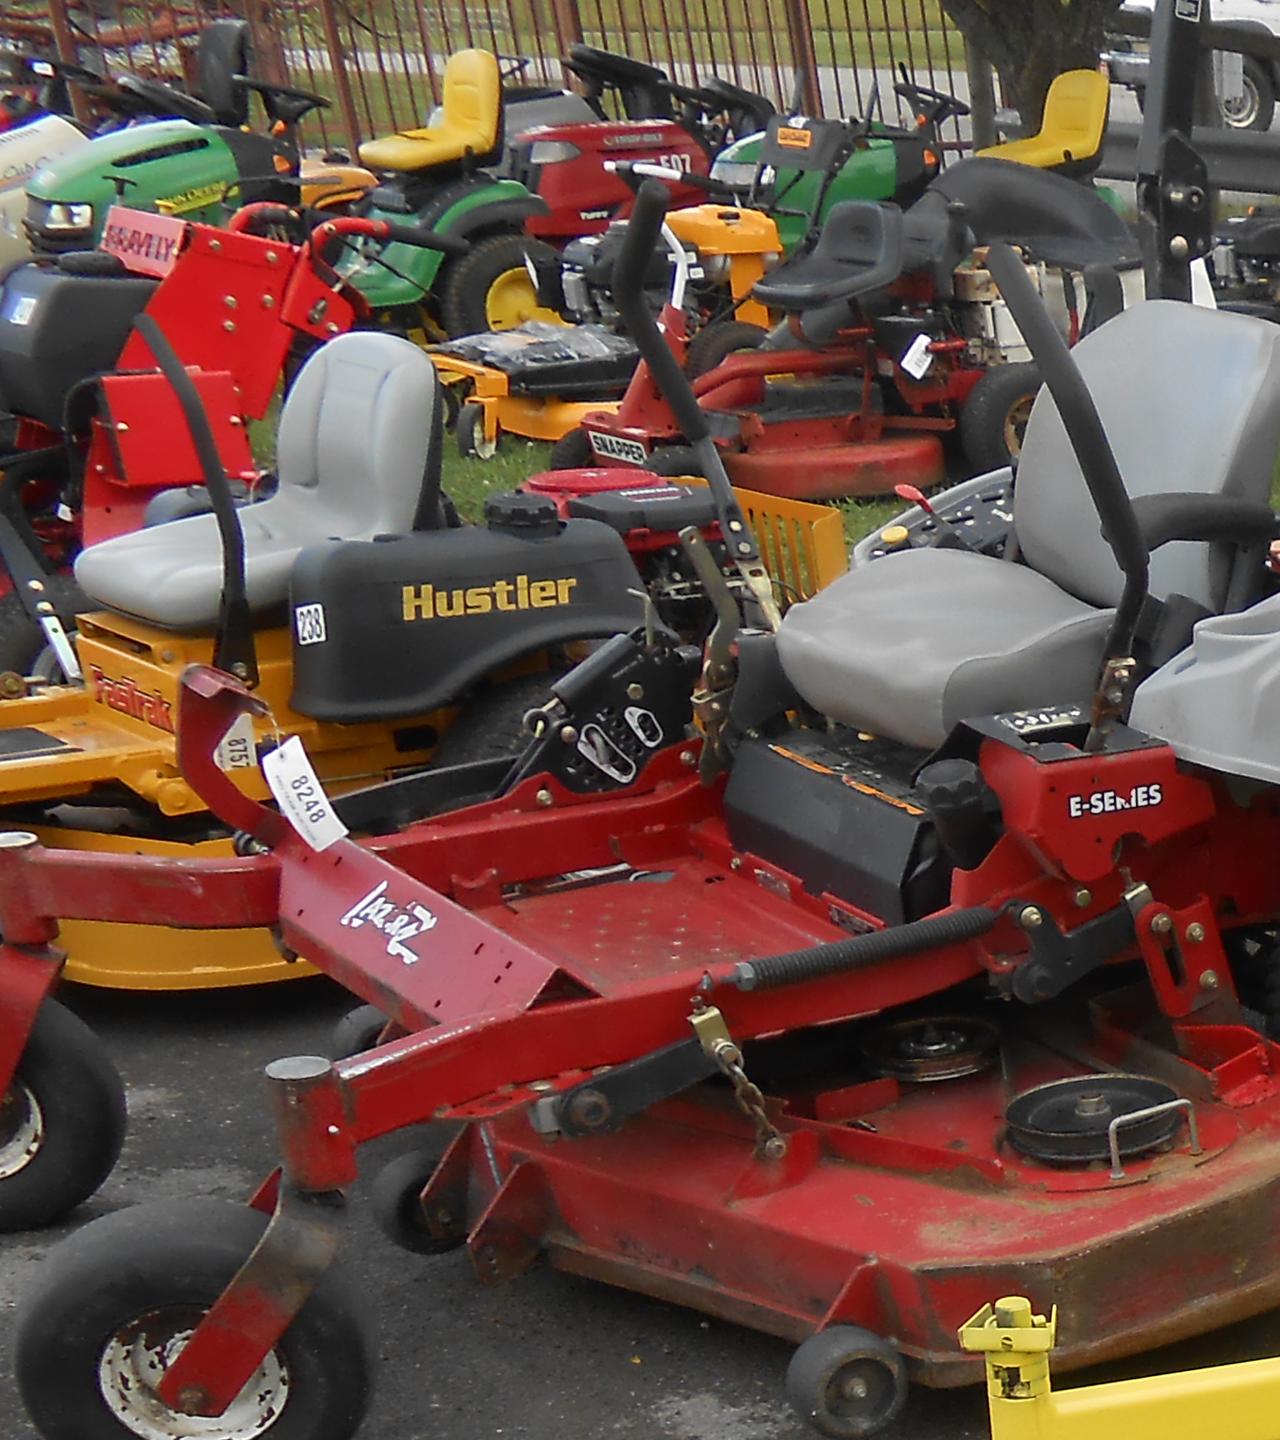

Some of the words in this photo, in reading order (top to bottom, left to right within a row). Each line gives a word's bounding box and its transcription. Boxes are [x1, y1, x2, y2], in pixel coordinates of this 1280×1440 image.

[593, 434, 644, 462] SNAPPER
[402, 575, 577, 621] Hustler
[299, 608, 322, 641] 238
[291, 775, 326, 823] 8248
